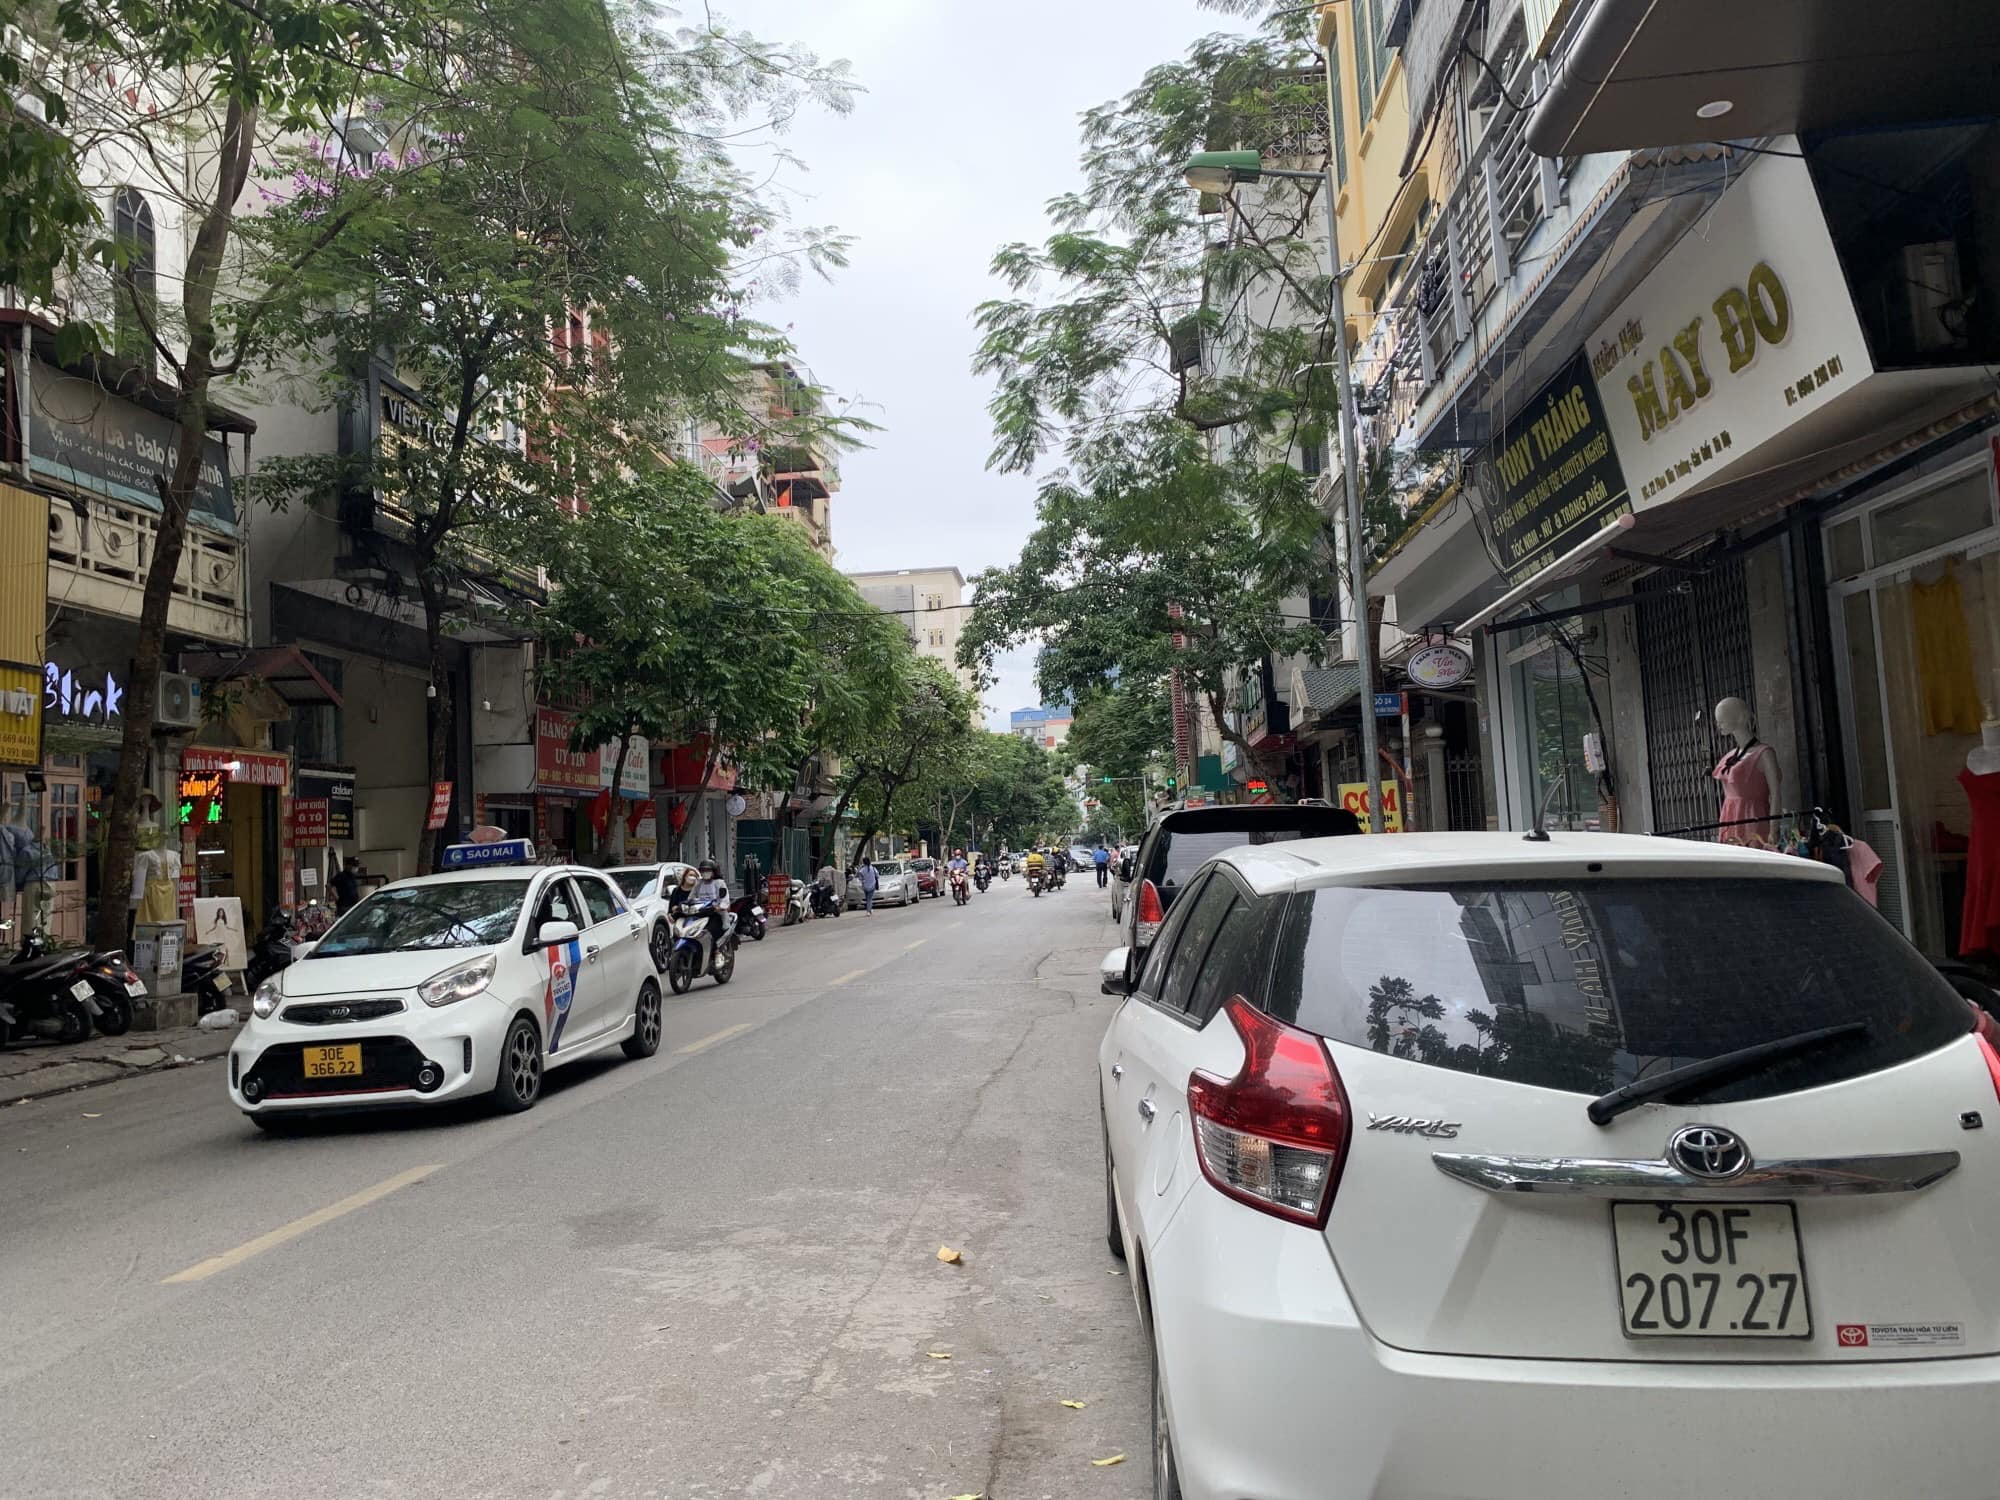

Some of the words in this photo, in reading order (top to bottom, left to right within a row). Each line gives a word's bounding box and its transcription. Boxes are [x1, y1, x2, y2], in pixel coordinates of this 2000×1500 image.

[1627, 315, 1712, 441] MAY
[1712, 261, 1791, 374] ĐO
[135, 432, 164, 465] Balo
[1496, 432, 1535, 492] TONY
[1531, 385, 1591, 461] THẮNG
[1511, 538, 1525, 559] TÓC
[1553, 513, 1563, 529] &
[1560, 495, 1587, 525] TRANG
[540, 717, 568, 740] HÀNG
[555, 748, 568, 765] UY
[310, 811, 322, 822] TÔ
[466, 848, 490, 860] SAO
[492, 846, 513, 857] MAI
[319, 1047, 344, 1061] 30E
[310, 1061, 356, 1076] 366.22
[1366, 1112, 1462, 1138] YARIS
[1658, 1208, 1751, 1264] 30F
[1626, 1272, 1798, 1330] 207.27
